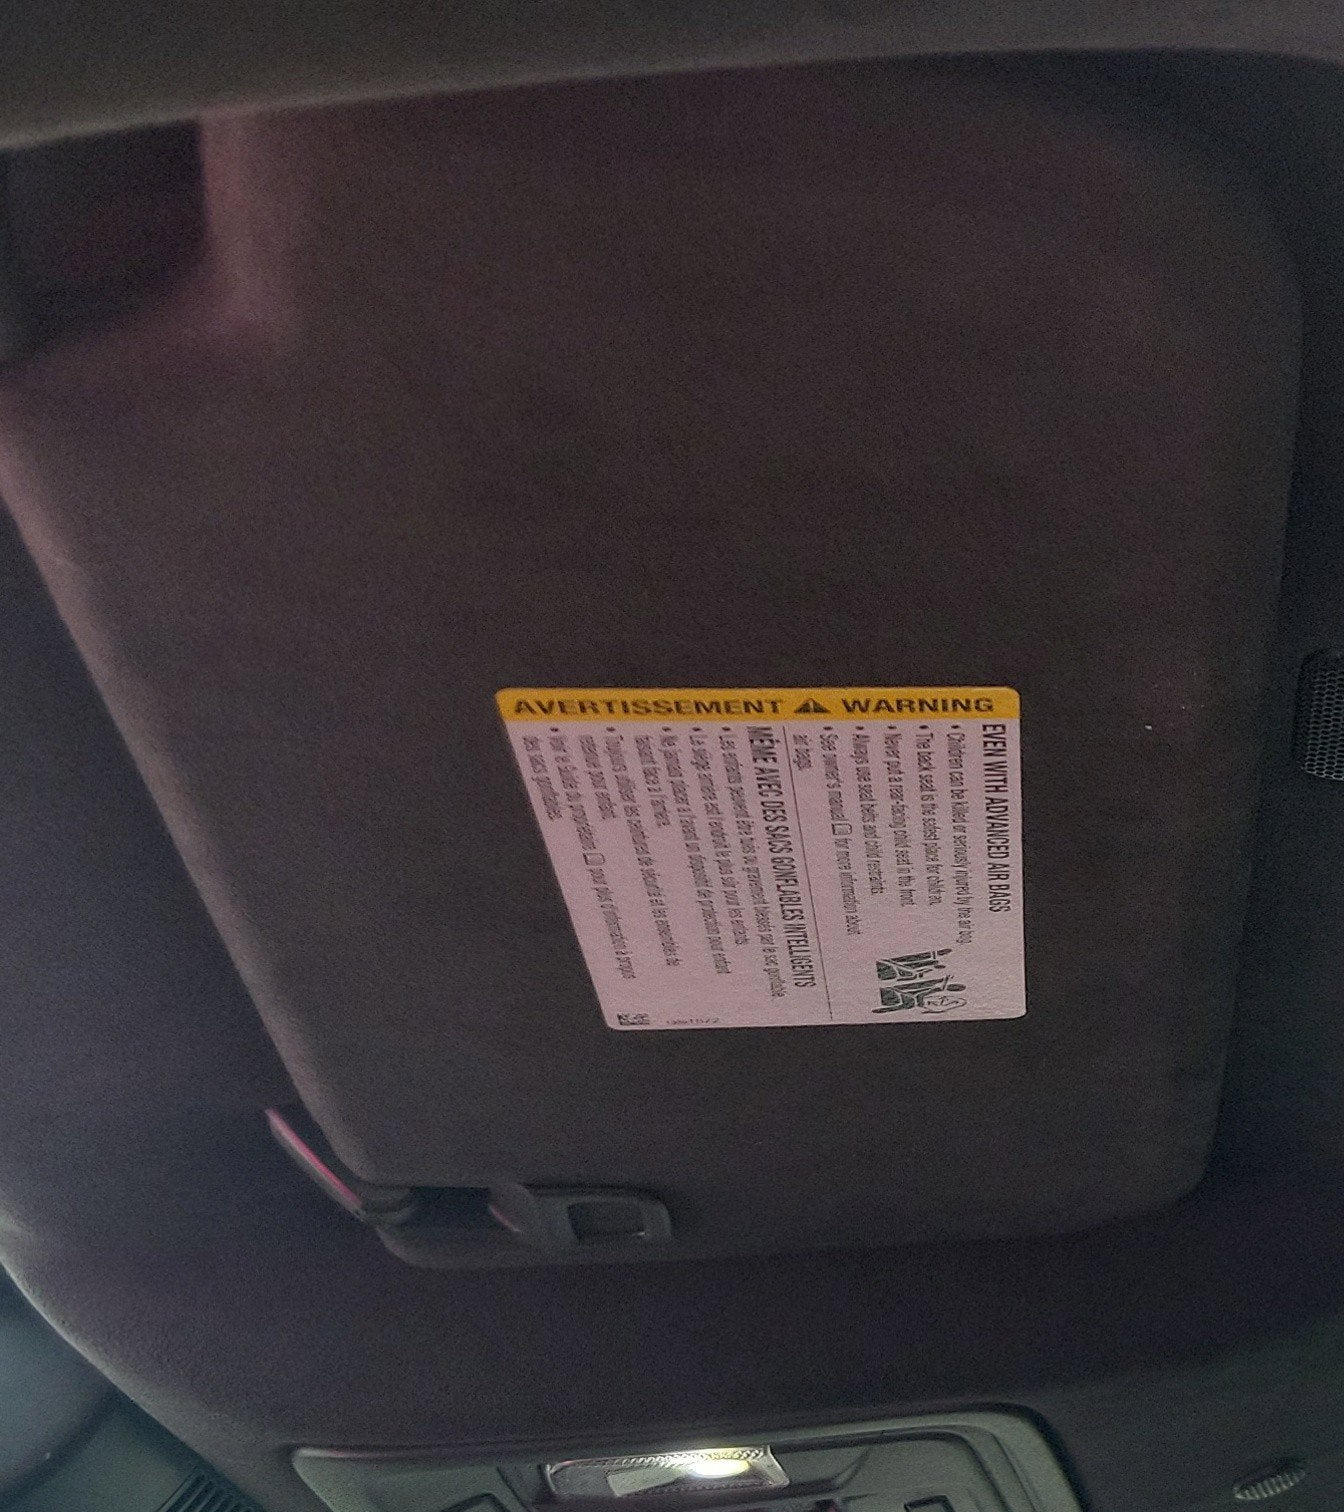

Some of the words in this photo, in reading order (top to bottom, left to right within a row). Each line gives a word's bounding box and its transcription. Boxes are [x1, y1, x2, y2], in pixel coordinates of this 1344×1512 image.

[515, 698, 783, 715] AVERTISSEMENT
[842, 697, 995, 714] WARNING
[748, 727, 779, 763] MÊME
[916, 733, 933, 748] The
[947, 733, 965, 768] Children
[983, 724, 1006, 756] EVEN
[917, 752, 935, 771] back
[754, 767, 782, 797] AVEC
[919, 775, 936, 791] seat
[949, 772, 963, 786] can
[984, 761, 1007, 792] WITH
[761, 801, 787, 822] DES
[921, 803, 938, 815] the
[952, 802, 969, 822] killed
[922, 818, 940, 840] safest
[985, 797, 1009, 859] ADVANCED
[765, 826, 792, 853] SACS
[922, 843, 941, 861] place
[951, 835, 971, 868] seriously
[926, 864, 943, 874] for
[988, 863, 1009, 880] AIR
[771, 857, 804, 920] GONFLABLES
[927, 876, 945, 905] children.
[953, 871, 972, 895] injured
[989, 884, 1010, 912] BAGS
[958, 908, 971, 918] the
[959, 920, 974, 929] air
[784, 924, 815, 987] INTELLIGENTS
